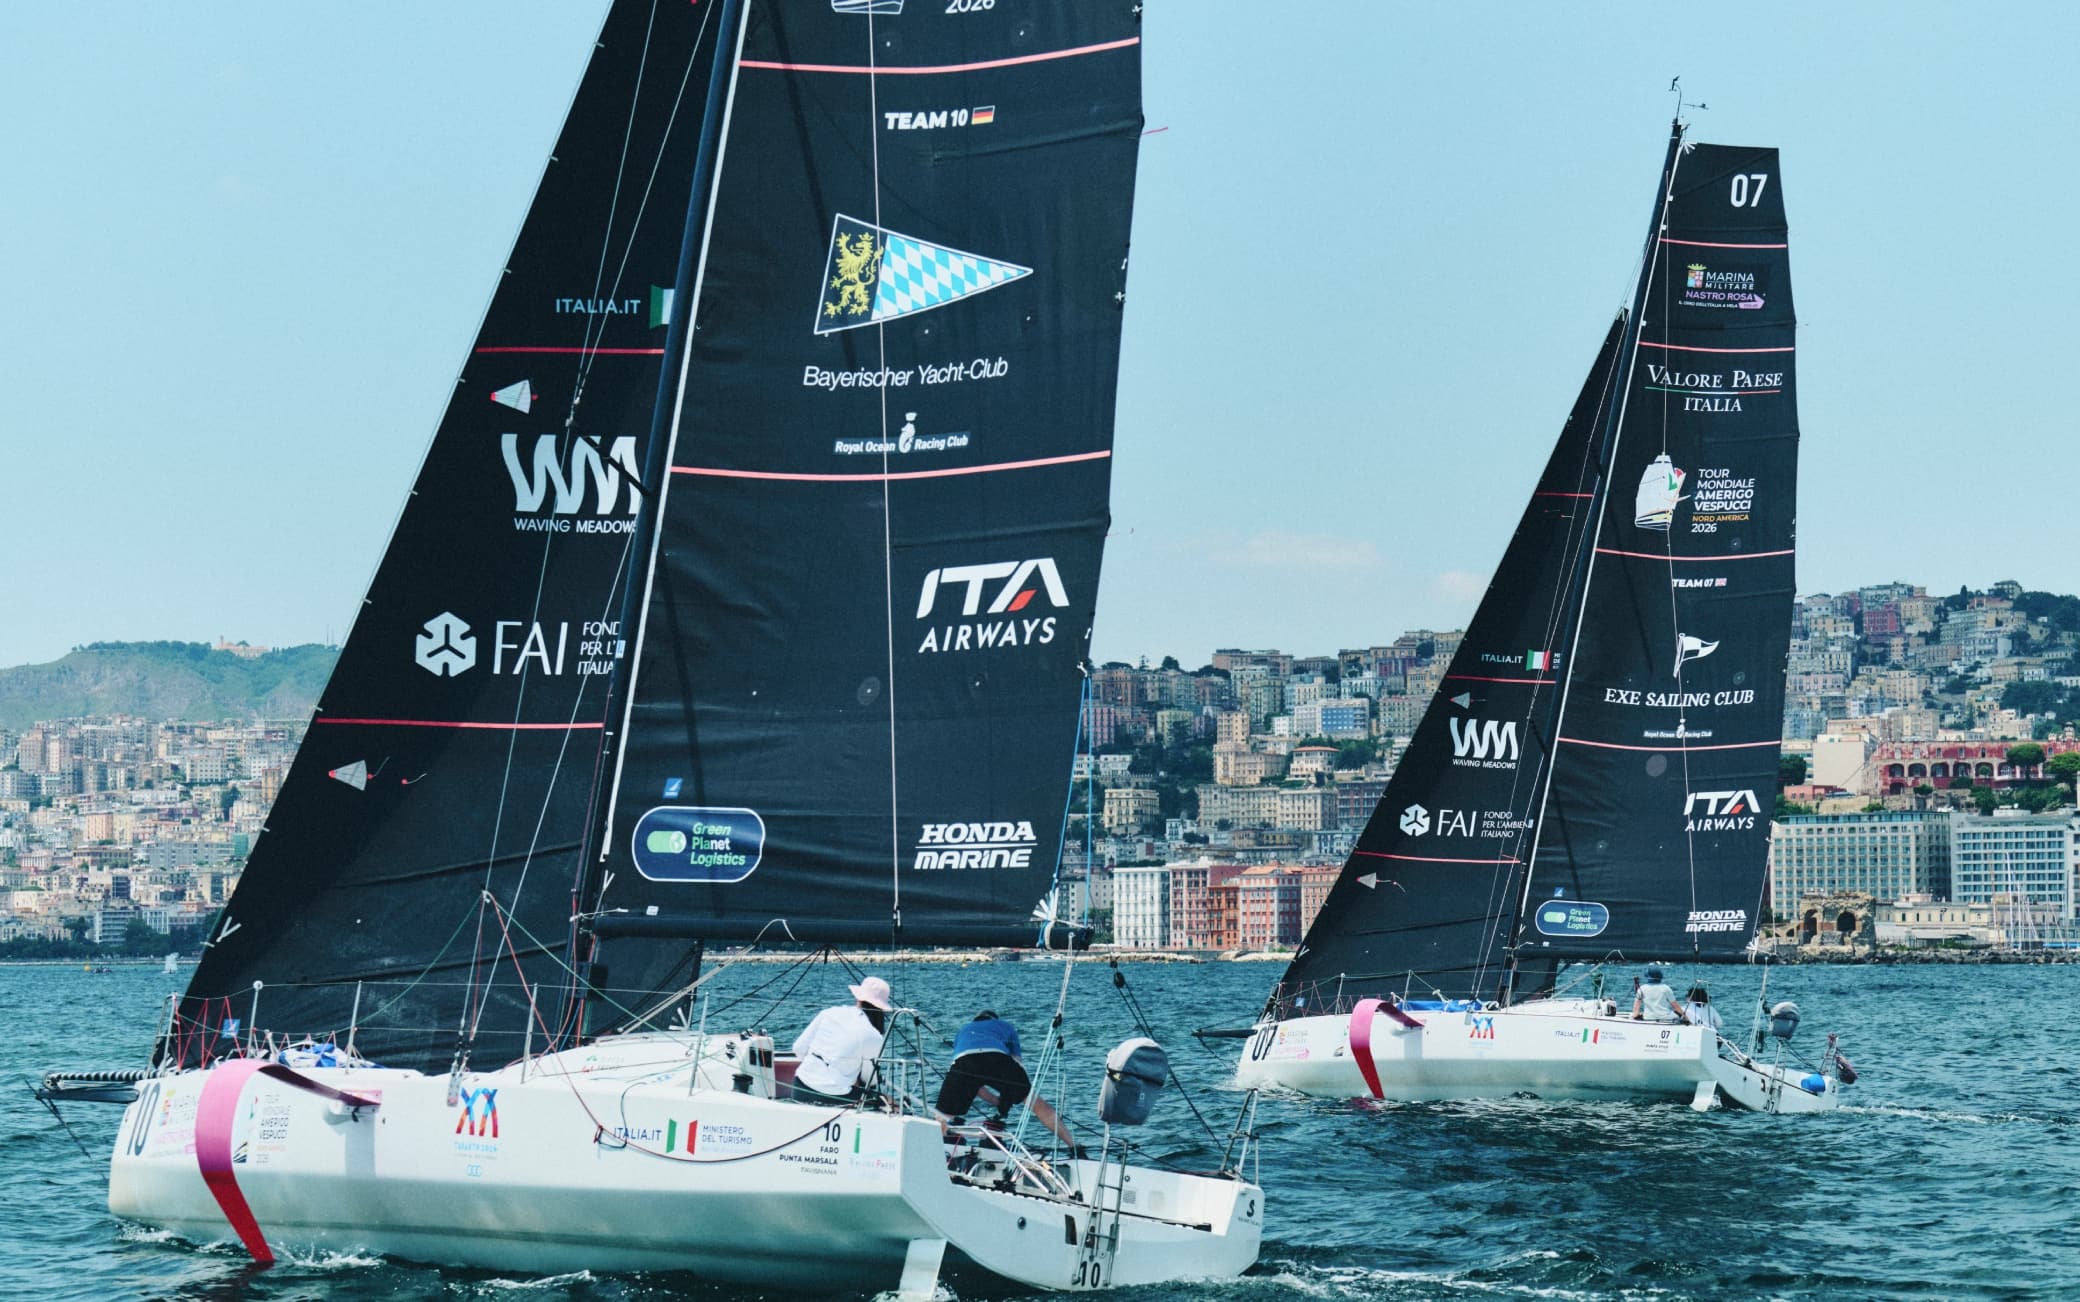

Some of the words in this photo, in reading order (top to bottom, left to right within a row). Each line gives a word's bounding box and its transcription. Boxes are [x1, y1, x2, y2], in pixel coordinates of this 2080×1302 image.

[945, 0, 995, 14] 2026
[885, 111, 948, 130] TEAM
[951, 109, 968, 127] 10
[1730, 174, 1768, 207] 07
[1706, 272, 1754, 282] MARINA
[1685, 290, 1725, 301] NASTRO
[1727, 292, 1753, 301] ROSA
[556, 299, 641, 314] ITALIA.IT
[803, 366, 914, 391] Bayerischer
[918, 357, 1009, 385] Yacht-Club
[1648, 364, 1722, 388] VALORE
[1732, 370, 1783, 388] PAESE
[1683, 398, 1742, 412] ITALIA
[835, 441, 864, 454] Royal
[865, 441, 896, 452] Ocean
[914, 438, 946, 450] Racing
[947, 435, 969, 447] Club
[1698, 468, 1730, 479] TOUR
[1697, 478, 1756, 489] MONDIALE
[1694, 489, 1755, 500] AMERIGO
[1694, 500, 1752, 511] VESPUCCI
[1692, 514, 1716, 522] NORD
[1717, 513, 1750, 521] AMERICA
[514, 518, 571, 532] WAVING
[1691, 523, 1717, 533] 2026
[916, 557, 1070, 620] ITA
[1672, 579, 1703, 588] TEAM
[1704, 578, 1714, 588] 07
[918, 617, 1056, 653] AIRWAYS
[493, 621, 569, 675] FAI
[580, 641, 603, 655] PER
[1481, 654, 1523, 664] ITALIA.IT
[577, 661, 614, 675] ITALIA
[1604, 688, 1641, 705] EXE
[1645, 692, 1710, 707] SAILING
[1714, 690, 1754, 705] CLUB
[1452, 759, 1480, 768] WAVING
[1482, 761, 1516, 770] MEADOWS
[1683, 790, 1761, 815] ITA
[693, 822, 732, 835] Green
[1436, 809, 1477, 837] FAI
[1483, 811, 1513, 819] FONDO
[1482, 821, 1495, 829] PER
[1685, 817, 1754, 832] AIRWAYS
[919, 821, 1037, 843] HONDA
[1481, 830, 1514, 838] ITALIANO
[692, 837, 731, 850] Planet
[690, 852, 746, 867] Logistics
[914, 849, 1032, 869] MARINE
[1687, 910, 1747, 921] HONDA
[1685, 922, 1745, 933] MARINE
[1661, 1030, 1670, 1039] 07
[1252, 1025, 1278, 1061] 07
[614, 1127, 663, 1141] ITALIA.IT
[703, 1125, 744, 1135] MINISTERO
[823, 1122, 841, 1142] 10
[702, 1135, 716, 1143] DEL
[719, 1135, 753, 1145] TURISMO
[820, 1146, 839, 1154] FARO
[779, 1155, 802, 1163] PUNTA
[804, 1156, 838, 1165] MARSALA
[1080, 1261, 1101, 1289] 10
